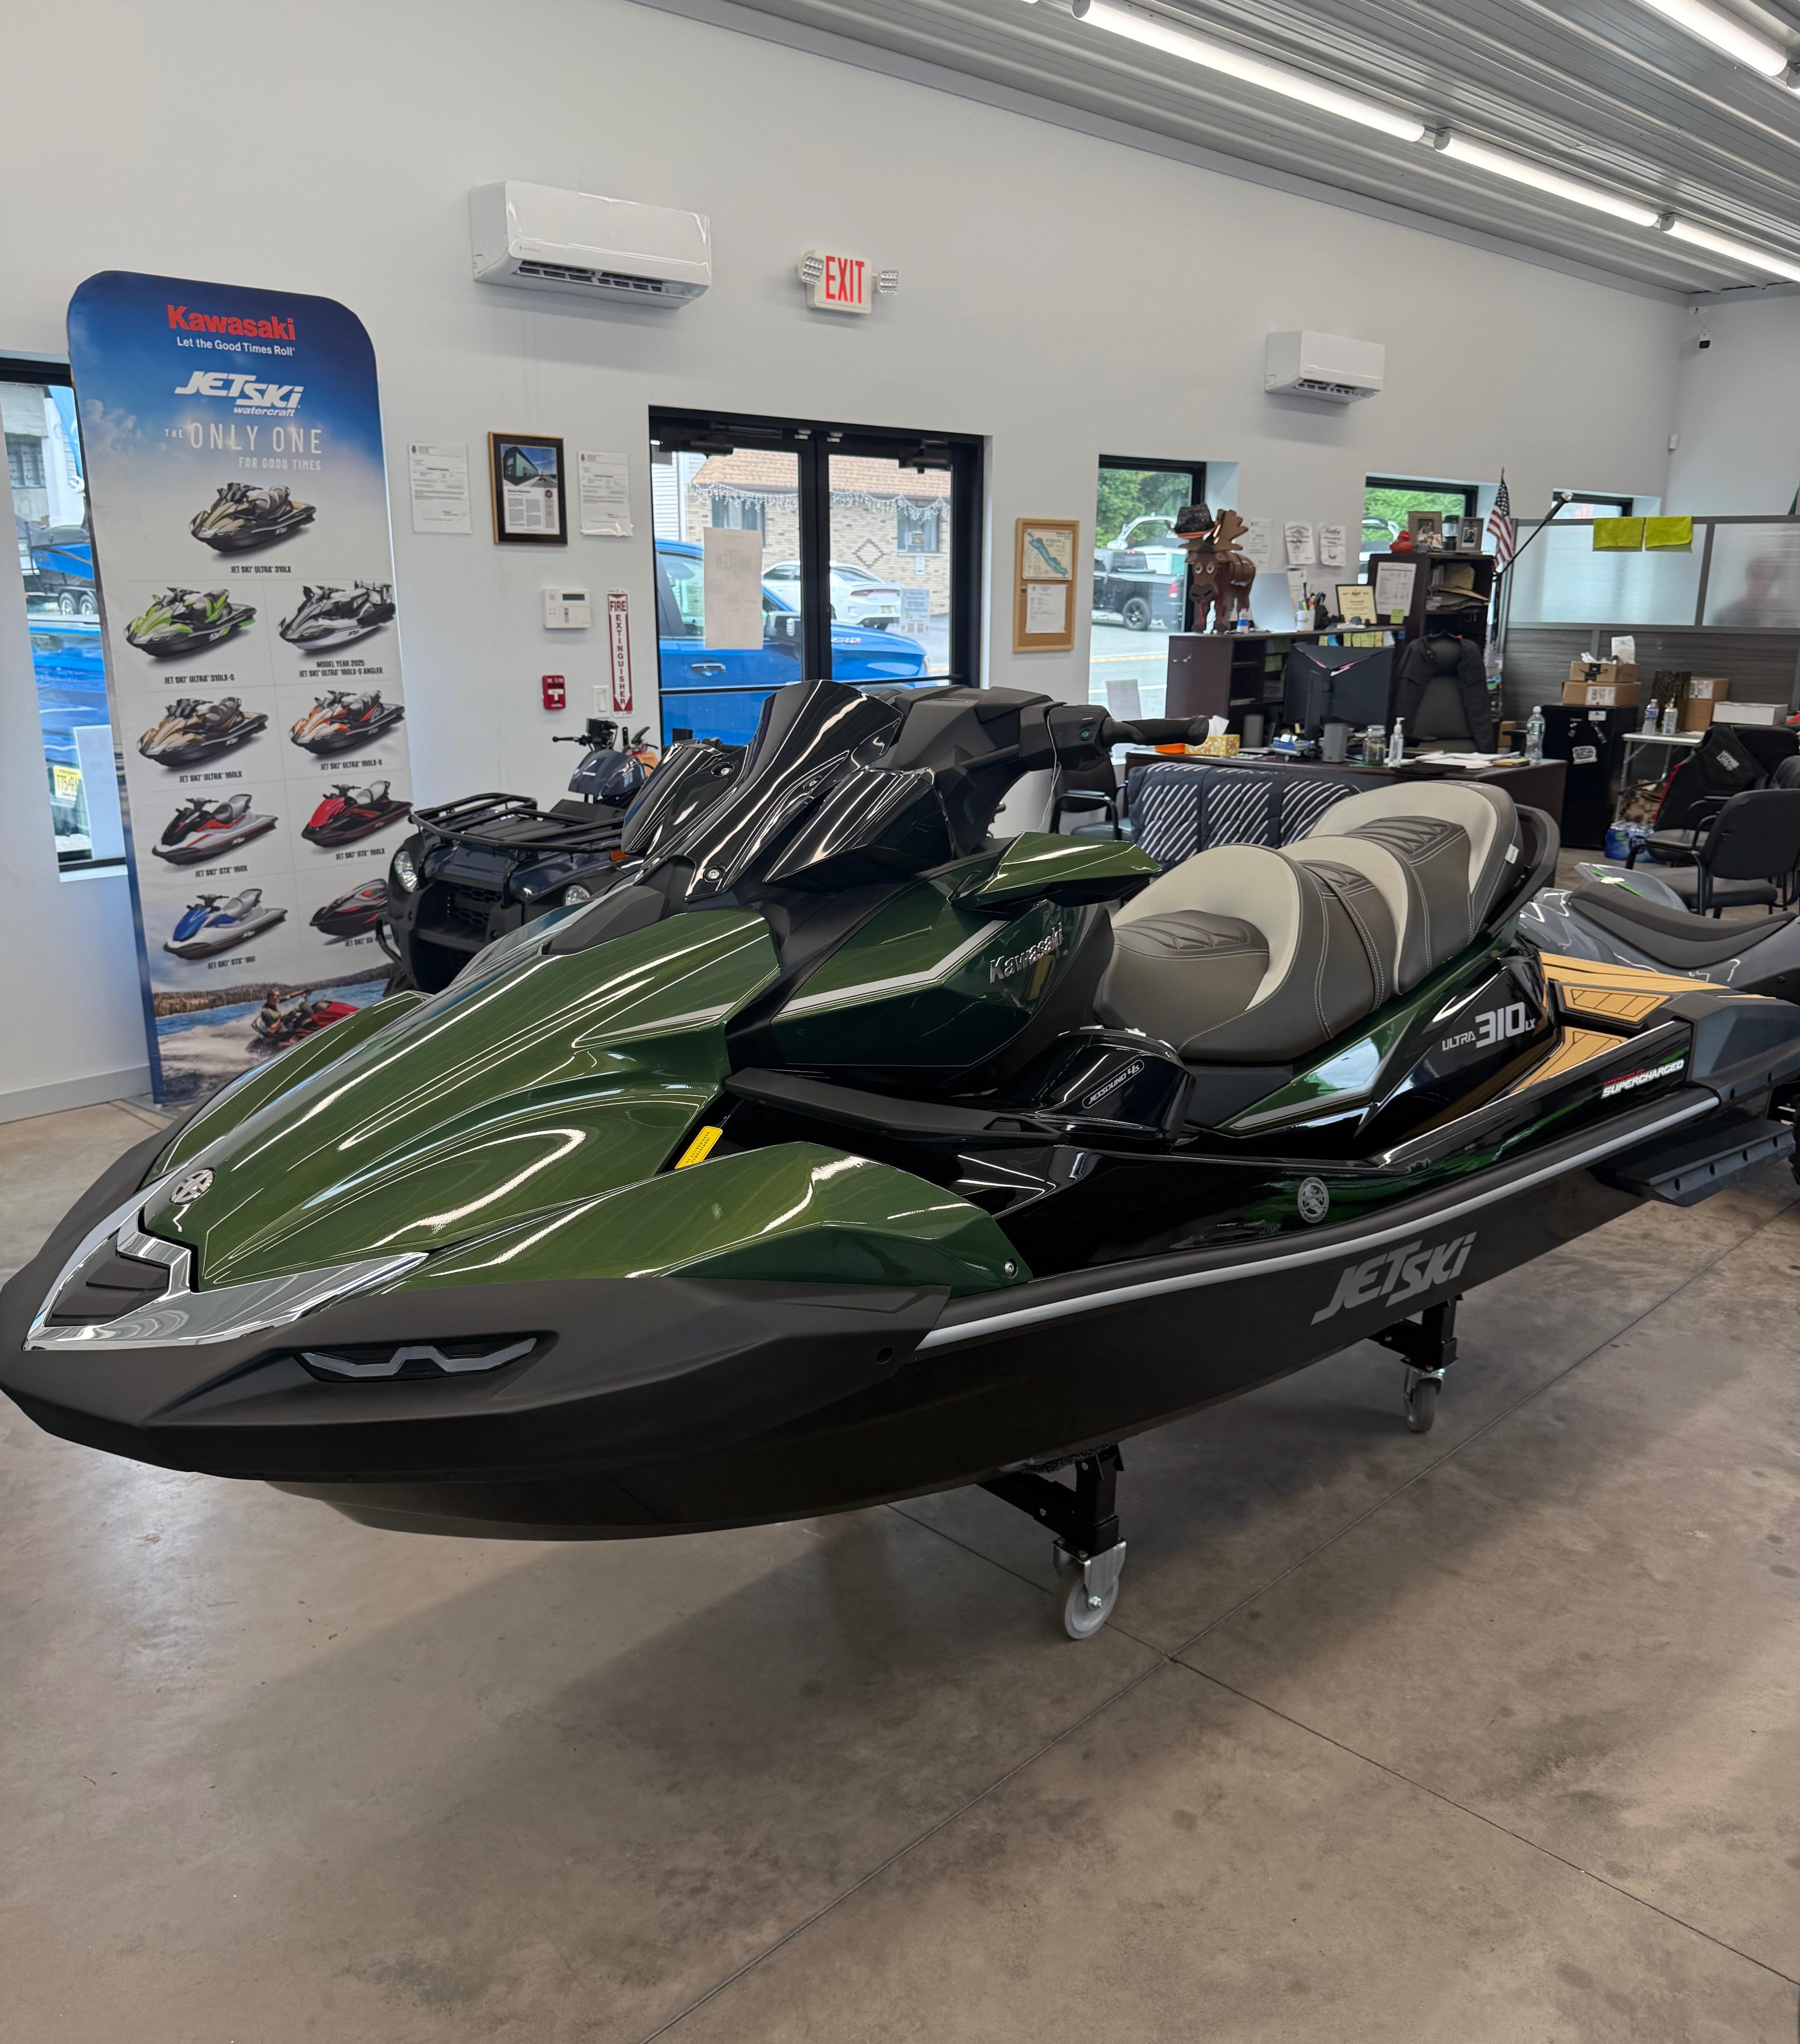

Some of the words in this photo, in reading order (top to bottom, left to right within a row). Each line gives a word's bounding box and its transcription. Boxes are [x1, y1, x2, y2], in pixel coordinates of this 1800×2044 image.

[825, 255, 865, 304] EXIT
[167, 305, 296, 341] Kawasaki
[177, 336, 194, 347] Let
[196, 338, 212, 349] the
[214, 340, 241, 351] Good
[243, 342, 272, 355] Times
[234, 406, 295, 417] watercraft
[164, 429, 183, 438] THE
[190, 422, 258, 451] ONLY
[273, 426, 322, 454] ONE
[238, 456, 257, 468] FOR
[262, 458, 288, 470] GOOD
[292, 459, 322, 471] TIMES
[231, 566, 240, 574] JET
[275, 566, 292, 574] 310LX
[609, 601, 627, 612] FIRE
[615, 614, 625, 705] EXTINGUISHER
[180, 775, 188, 783] JET
[989, 922, 1063, 984] Kawasaki
[1442, 1030, 1477, 1051] ULTRA
[1088, 1072, 1127, 1104] JETSOUND
[1601, 1058, 1685, 1099] SUPERCHARGED
